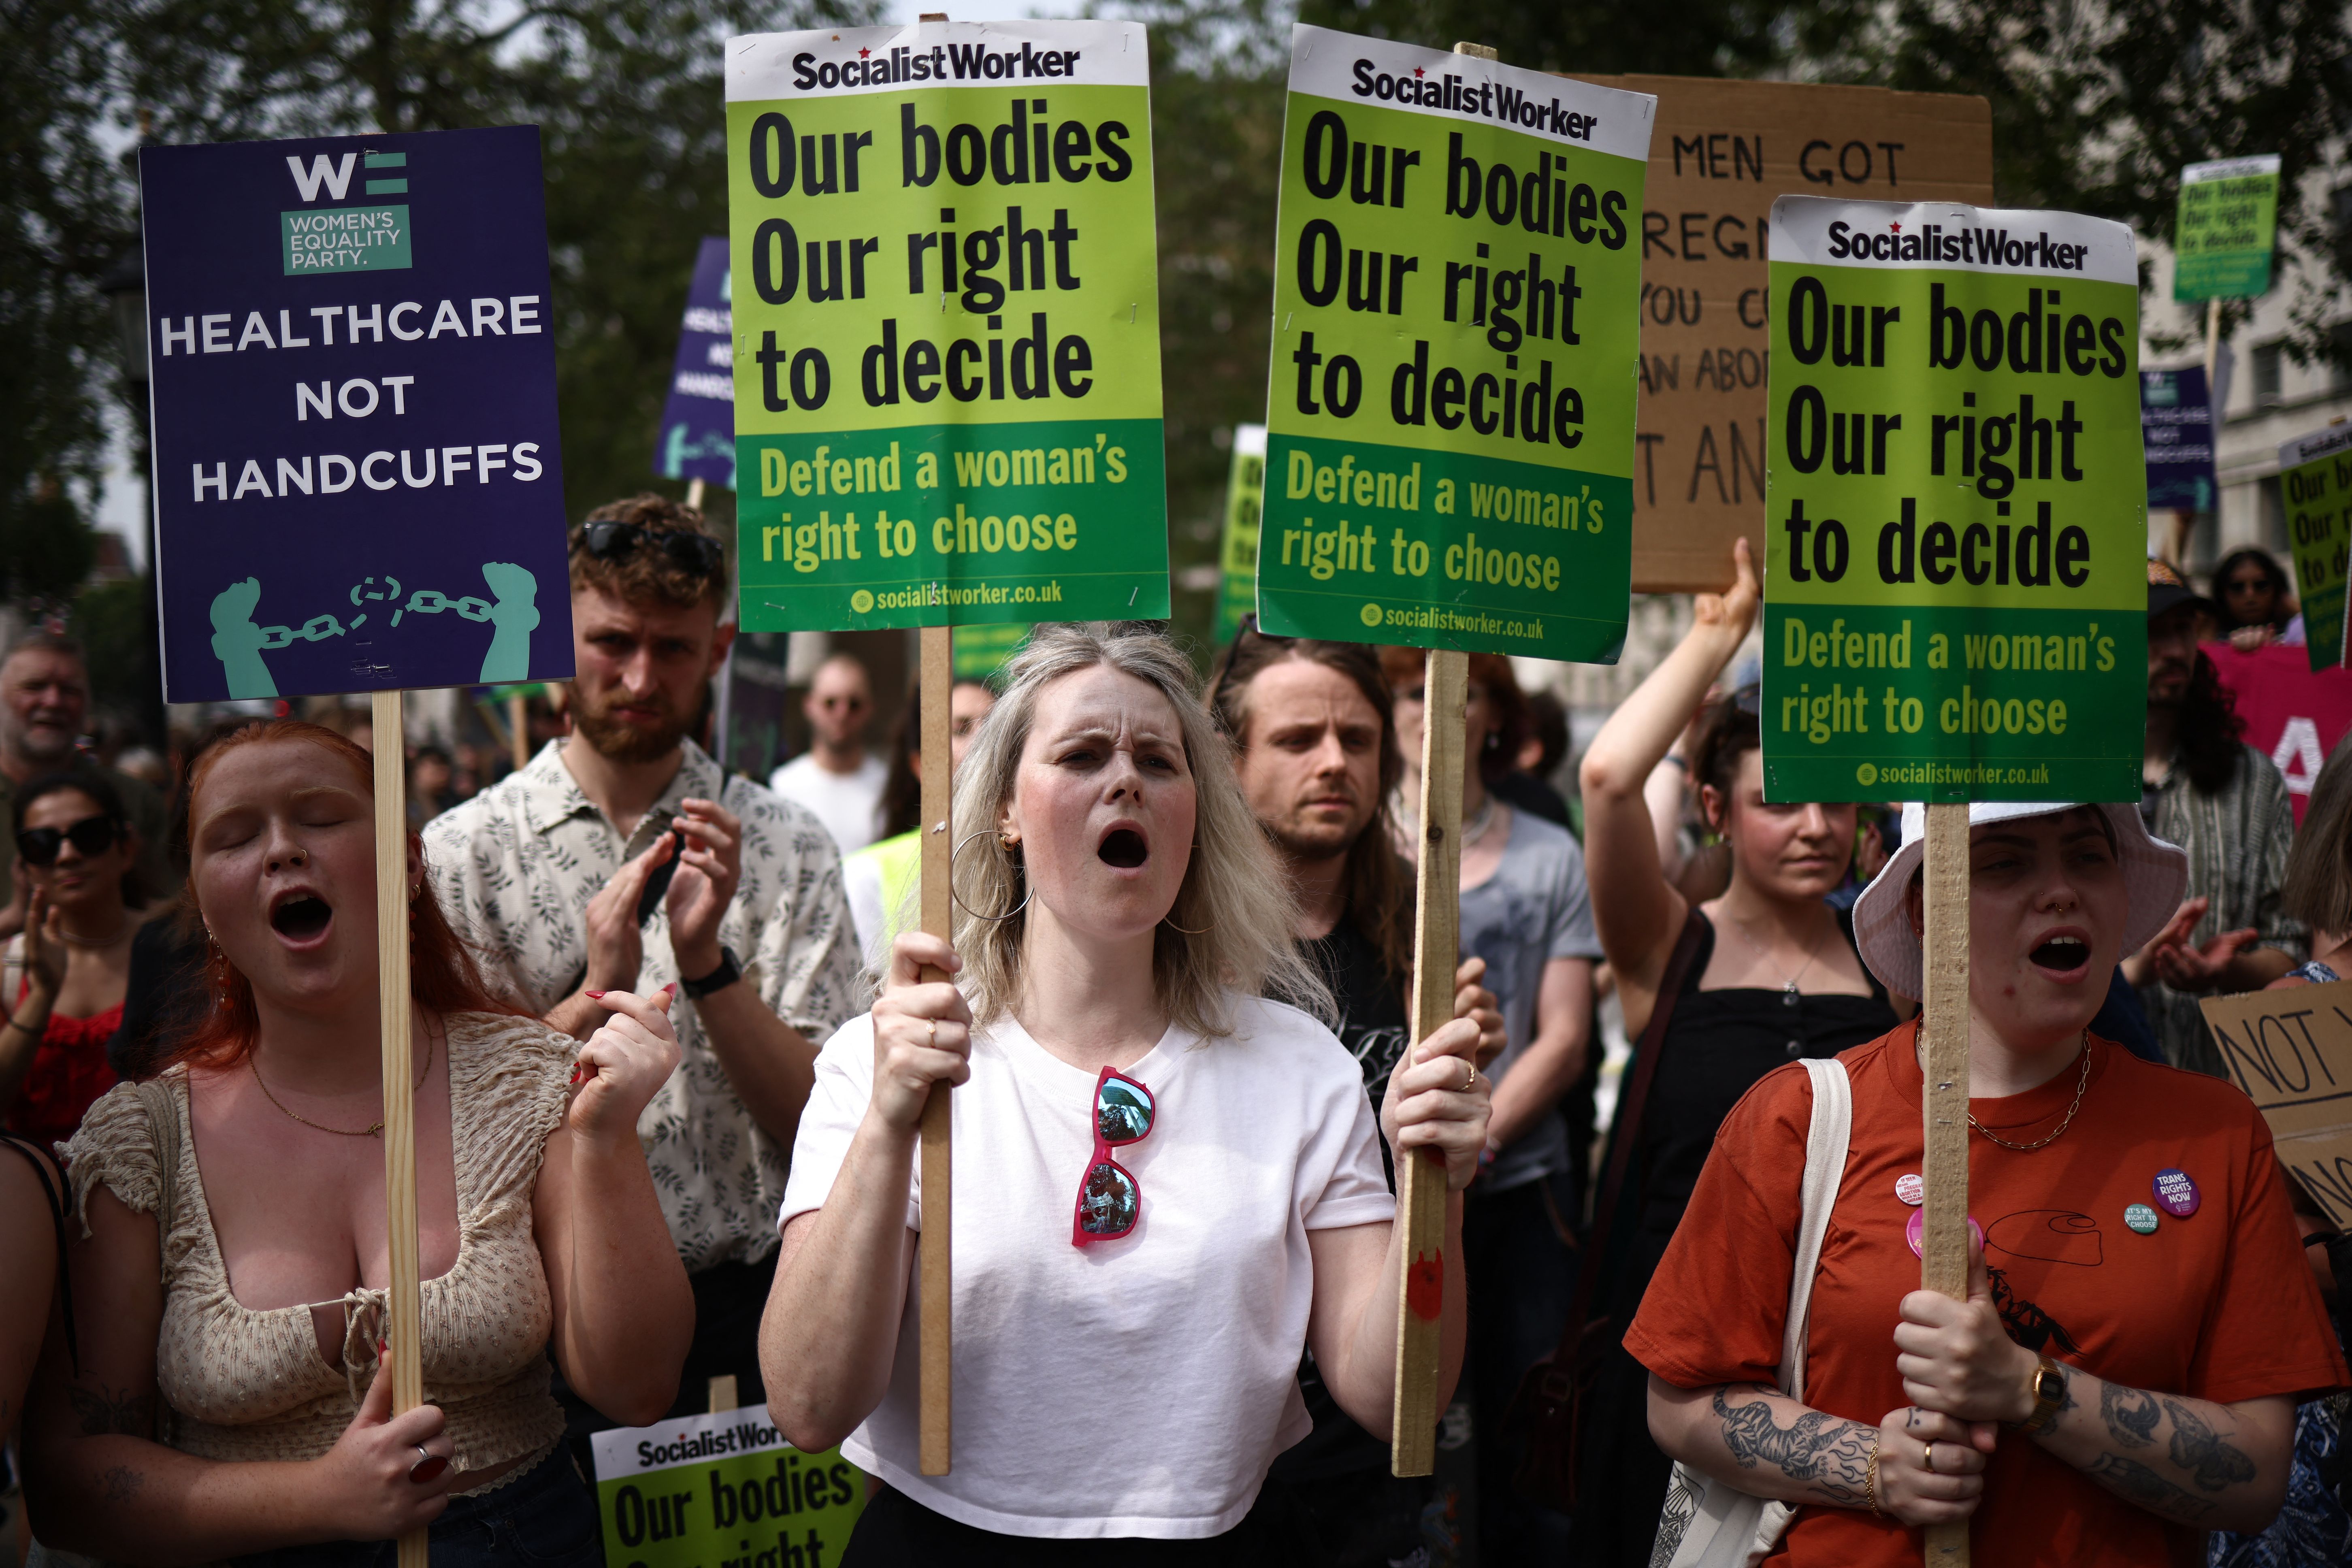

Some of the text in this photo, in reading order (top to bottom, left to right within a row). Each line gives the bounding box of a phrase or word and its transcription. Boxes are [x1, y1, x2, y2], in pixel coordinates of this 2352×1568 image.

[750, 99, 1132, 198] Our bodies
[1672, 134, 1905, 187] MEN GOT
[1303, 110, 1627, 250] Our bodies
[290, 212, 393, 233] WOMEN'S
[290, 230, 401, 251] EQUALITY
[291, 250, 367, 269] PARTY.
[752, 206, 1080, 314] Our right
[1297, 219, 1582, 352] Our right
[162, 295, 542, 356] HEALTHCARE
[1788, 276, 2126, 378] Our bodies
[756, 313, 1093, 412] to decide
[1293, 331, 1583, 449] to decide
[296, 376, 414, 420] NOT
[193, 442, 543, 502] HANDCUFFS
[761, 433, 1127, 497] Defend a woman's
[1786, 385, 2083, 499] Our right
[1286, 450, 1421, 511] Defend
[1435, 477, 1455, 515] a
[1470, 485, 1604, 534] woman's
[2290, 470, 2327, 505] Our
[763, 503, 1077, 573] right to choose
[1281, 517, 1560, 592] right to choose
[1785, 497, 2090, 588] to decide
[2295, 512, 2333, 547] Our
[877, 580, 1062, 610] socialistworker.co.uk
[1386, 606, 1543, 639] socialistworker.co.uk
[1784, 618, 2115, 671] Defend a woman's
[1782, 684, 2067, 744] right to choose
[1881, 763, 2049, 784] socialistworker.co.uk
[2215, 1010, 2335, 1097] NOT
[1899, 1189, 1921, 1197] ABORTION
[2157, 1174, 2186, 1185] TRANS
[2159, 1182, 2192, 1195] RIGHTS
[2168, 1192, 2190, 1203] NOW
[615, 1455, 853, 1548] Our bodies
